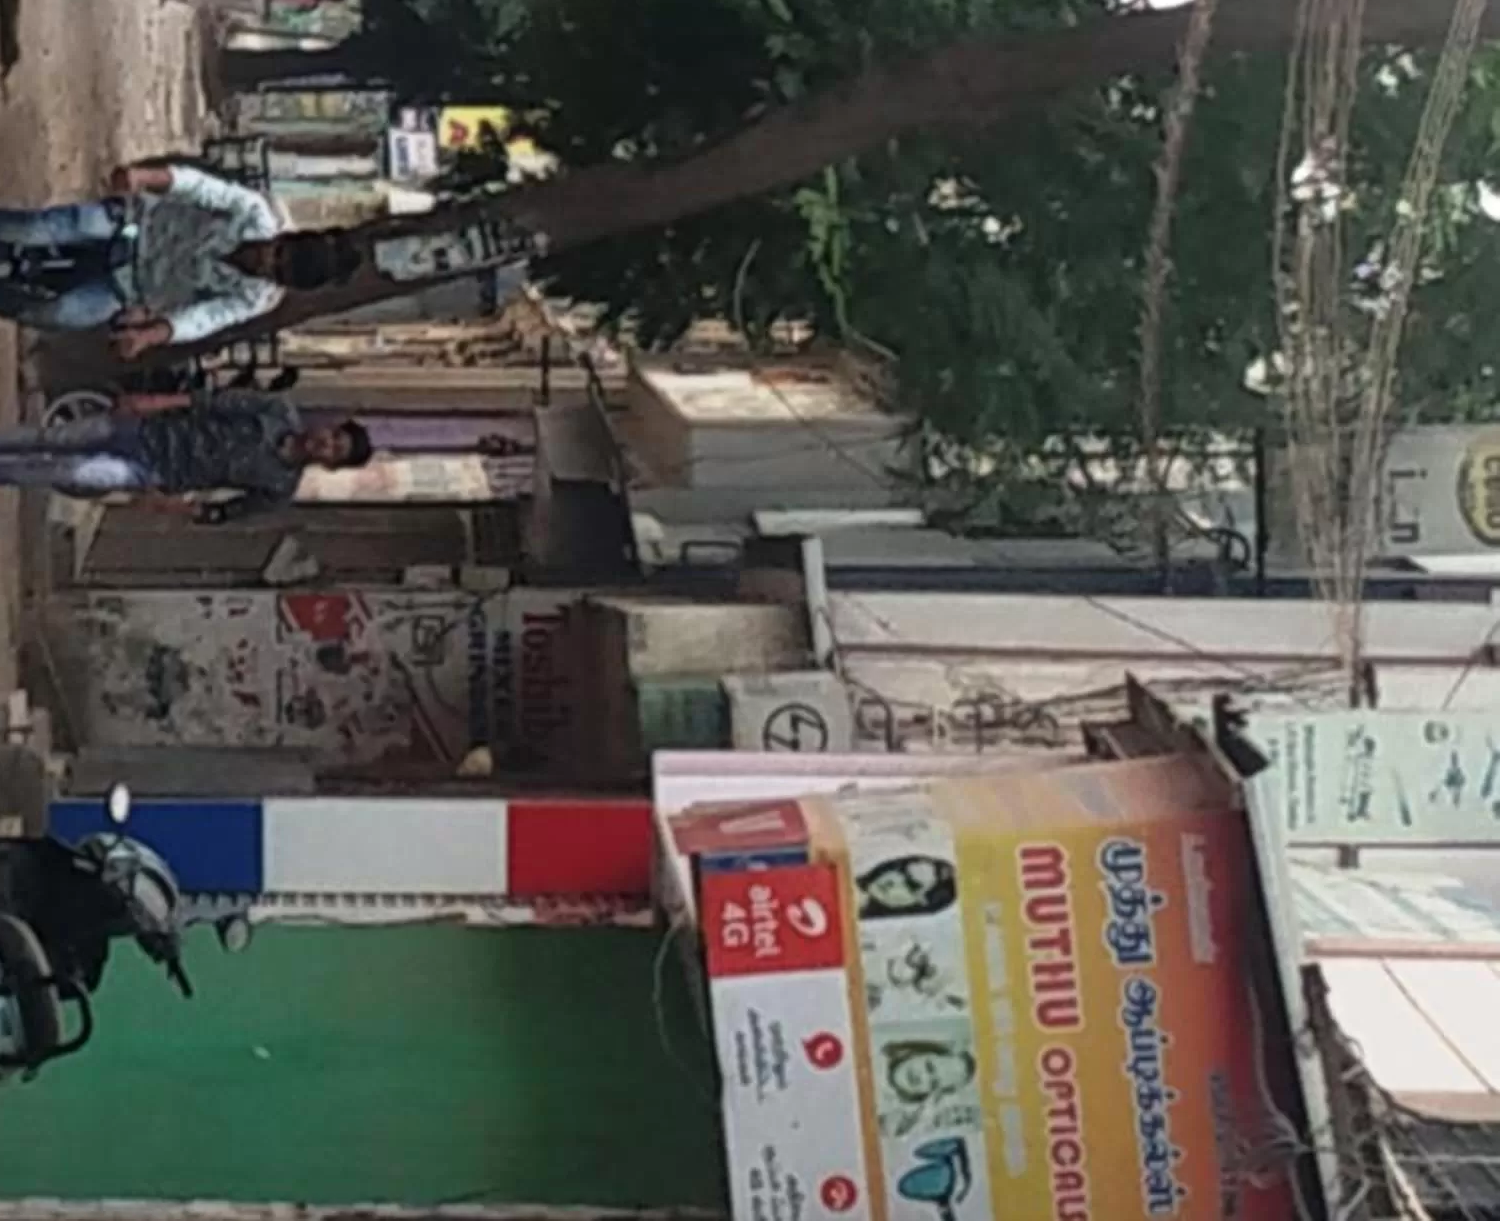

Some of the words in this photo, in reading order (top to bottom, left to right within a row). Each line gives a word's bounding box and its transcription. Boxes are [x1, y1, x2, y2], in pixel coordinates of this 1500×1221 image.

[520, 606, 571, 767] Toshib
[720, 901, 751, 948] 4G
[747, 883, 780, 958] airtel
[1019, 845, 1082, 1029] MUTHU
[1099, 843, 1166, 966] முத்து
